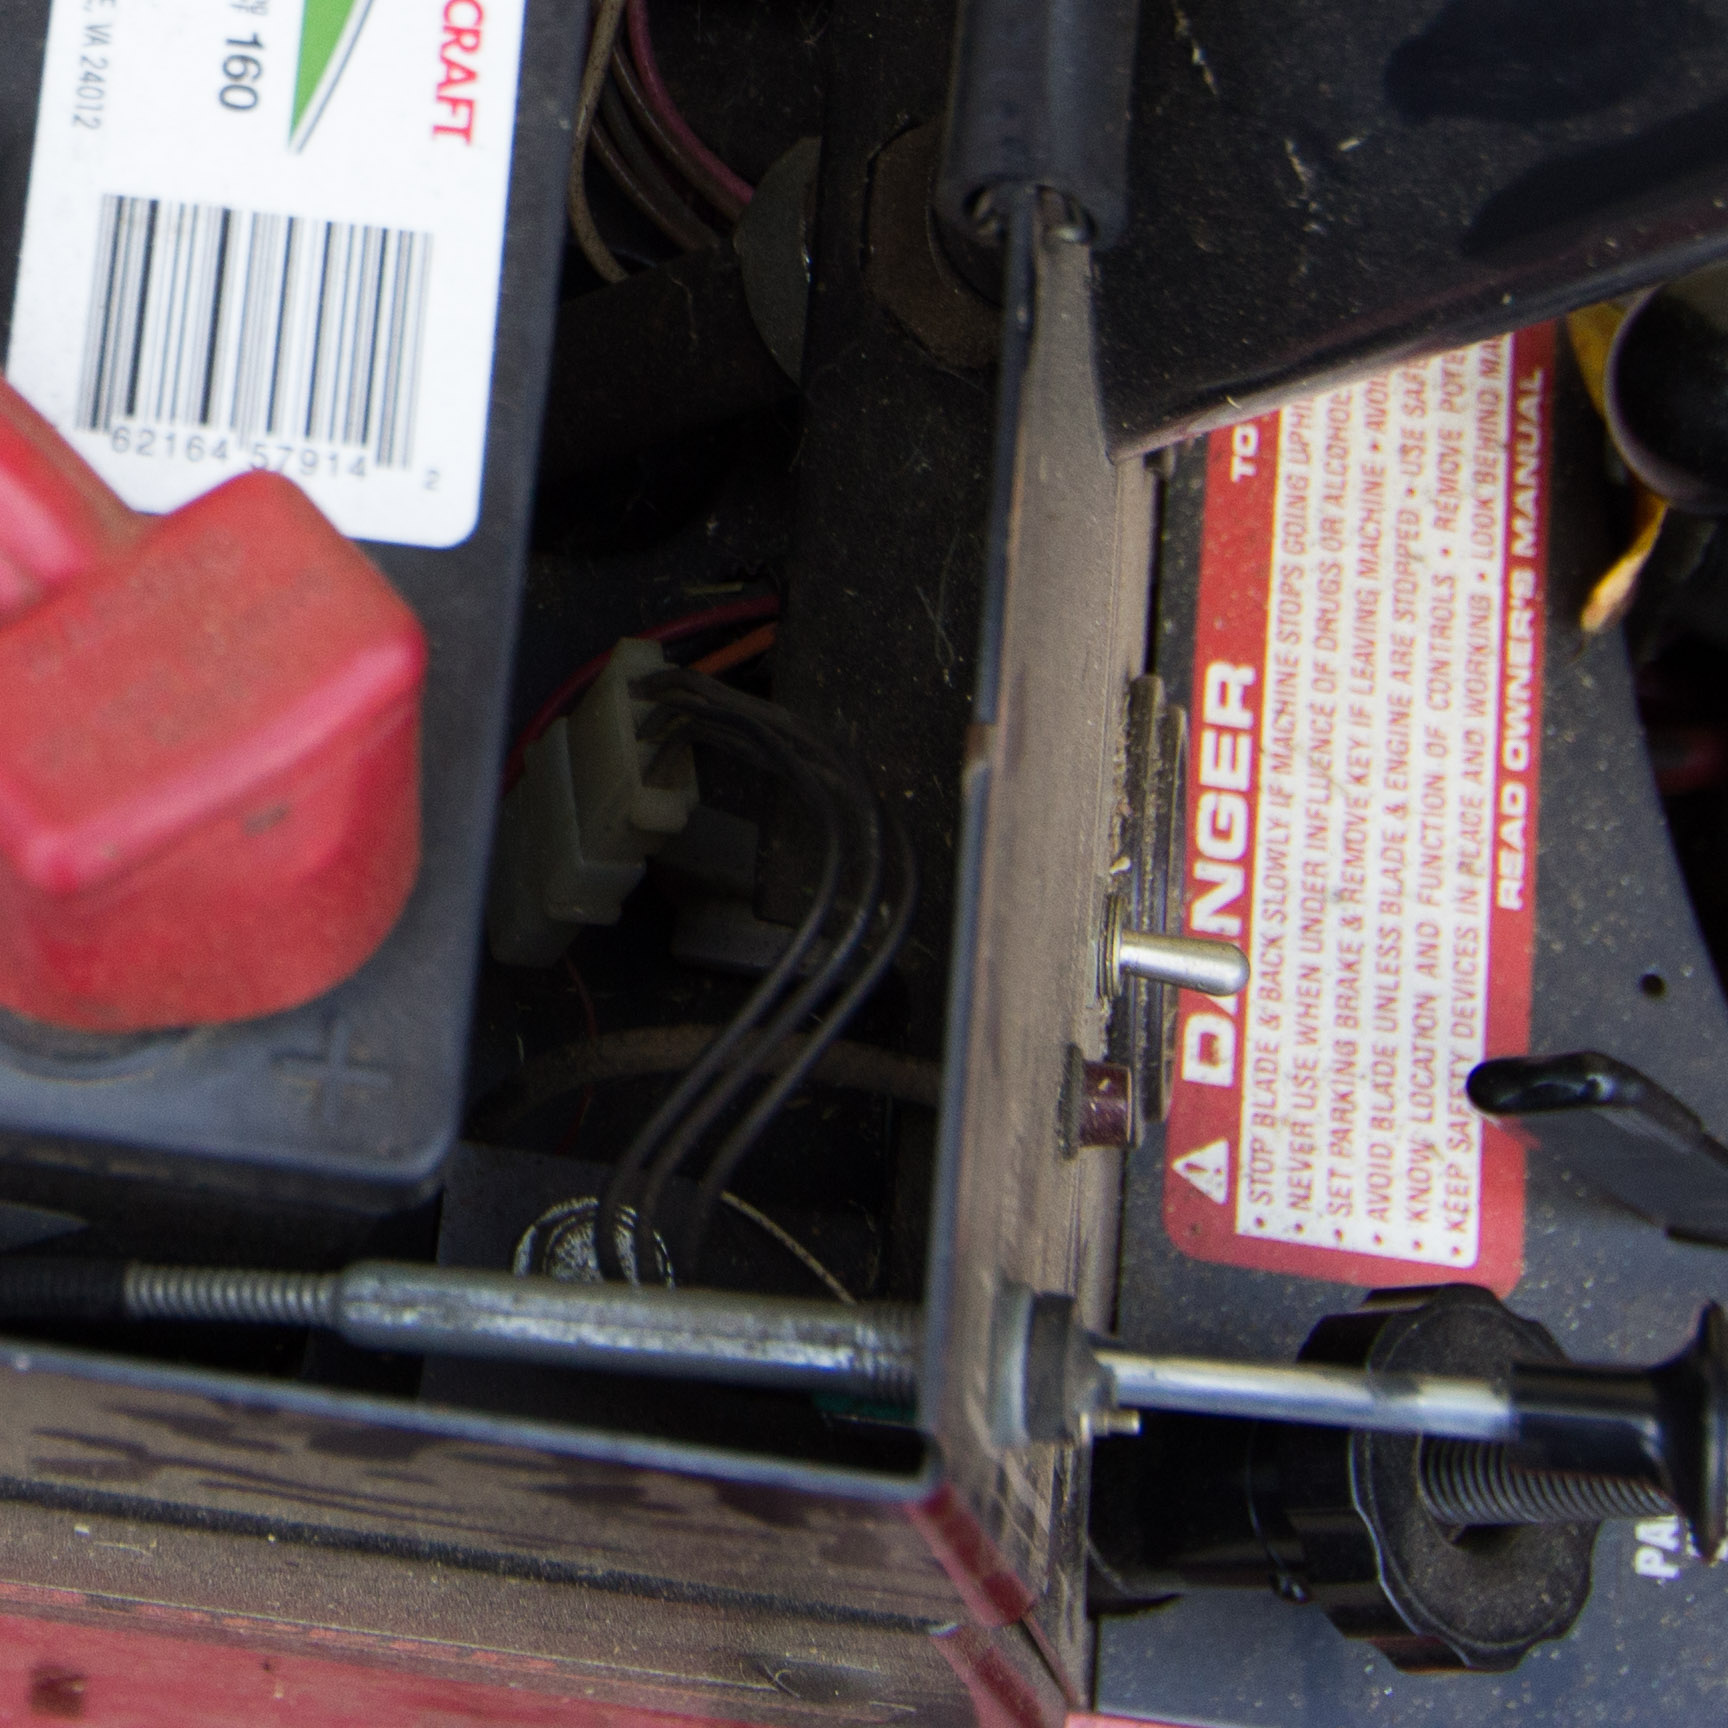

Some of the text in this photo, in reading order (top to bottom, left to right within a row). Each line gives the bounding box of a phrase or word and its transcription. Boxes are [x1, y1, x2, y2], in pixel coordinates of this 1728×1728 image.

[83, 22, 111, 47] VA
[217, 32, 264, 112] 160
[71, 54, 109, 130] 24012
[110, 424, 441, 492] 62164 57914 2
[1397, 426, 1426, 477] USE
[1472, 389, 1504, 484] BEHIND
[1281, 472, 1309, 555] GOING
[1318, 515, 1344, 553] OR
[1355, 463, 1385, 579] MACHINE
[1470, 495, 1497, 560] LOOK
[1275, 563, 1305, 644] STOPS
[1390, 506, 1421, 622] STOPPED
[1312, 561, 1342, 651] DRUGS
[1349, 588, 1380, 695] LEAVING
[1495, 371, 1541, 910] READ OWNER'S MANUAL
[1309, 659, 1337, 693] OF
[1388, 632, 1415, 684] ARE
[1463, 593, 1492, 717] WORKING
[1268, 654, 1299, 774] MACHINE
[1346, 702, 1372, 728] IF
[1382, 693, 1412, 791] ENGINE
[1266, 783, 1294, 808] IF
[1303, 701, 1336, 850] INFLUENCE
[1345, 736, 1371, 787] KEY
[1460, 728, 1486, 784] AND
[1336, 795, 1369, 904] REMOVE
[1405, 427, 1463, 1222] KNOW LOCATION AND FUNCTION OF CONTROLS REMOVE
[1454, 795, 1485, 877] PLACE
[1181, 662, 1253, 1084] DNGER
[1260, 816, 1290, 923] SLOWLY
[1298, 859, 1327, 953] UNDER
[1376, 830, 1407, 915] BLADE
[1454, 886, 1479, 915] IN
[1256, 932, 1284, 1002] BACK
[1294, 964, 1321, 1045] WHEN
[1333, 941, 1364, 1029] BRAKE
[1372, 925, 1402, 1033] UNLESS
[1448, 925, 1479, 1040] DEVICES
[1249, 1040, 1279, 1128] BLADE
[1290, 1057, 1319, 1110] USE
[1327, 1038, 1358, 1157] PARKING
[1368, 1043, 1398, 1131] BLADE
[1246, 1136, 1275, 1205] STOP
[1286, 1120, 1316, 1211] NEVER
[1324, 1166, 1354, 1217] SET
[1365, 1140, 1394, 1221] AVOID
[1441, 1162, 1471, 1232] KEEP
